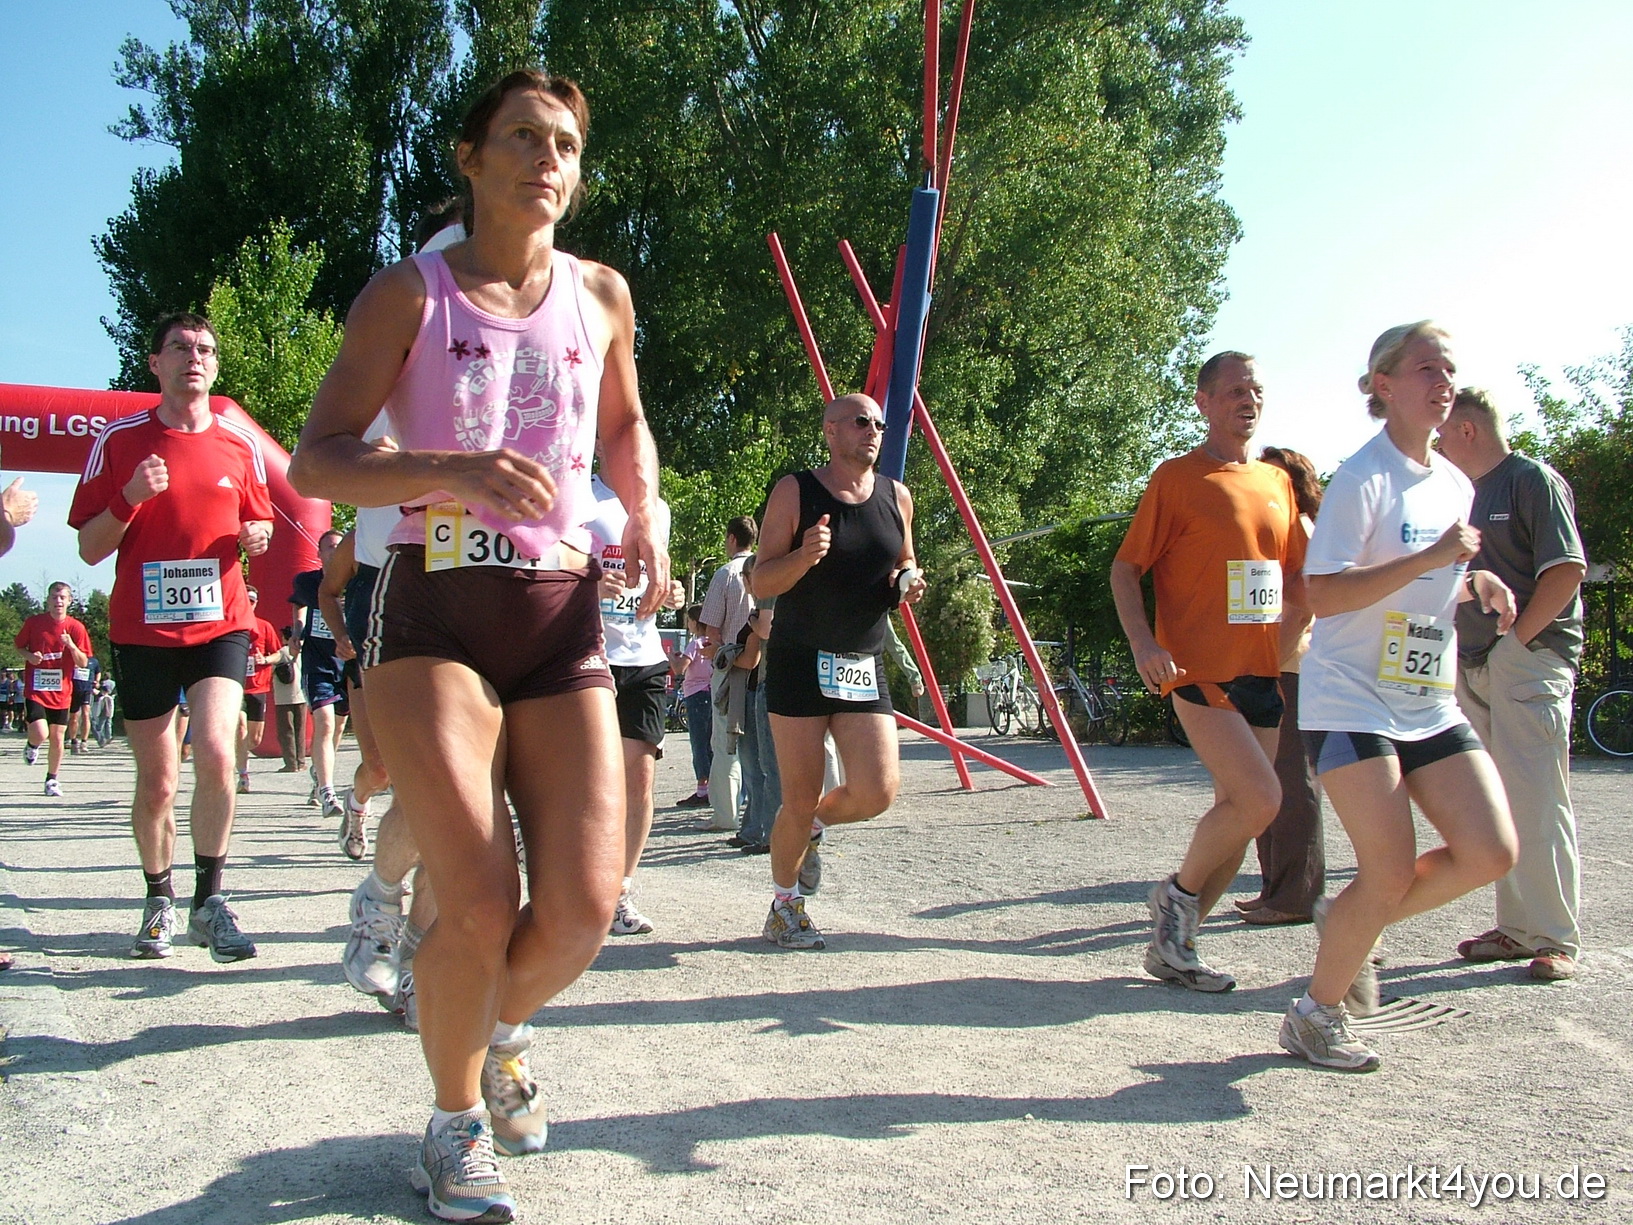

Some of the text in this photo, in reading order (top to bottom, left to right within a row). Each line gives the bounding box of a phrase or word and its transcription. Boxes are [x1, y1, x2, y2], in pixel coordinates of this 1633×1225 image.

[0, 413, 107, 439] ng LGS
[435, 524, 451, 543] C
[163, 567, 214, 579] Johannes
[148, 584, 214, 606] C 3011
[1249, 588, 1279, 606] 1051
[1388, 641, 1442, 677] C 521
[41, 678, 61, 686] 2550
[821, 661, 872, 687] C 3026
